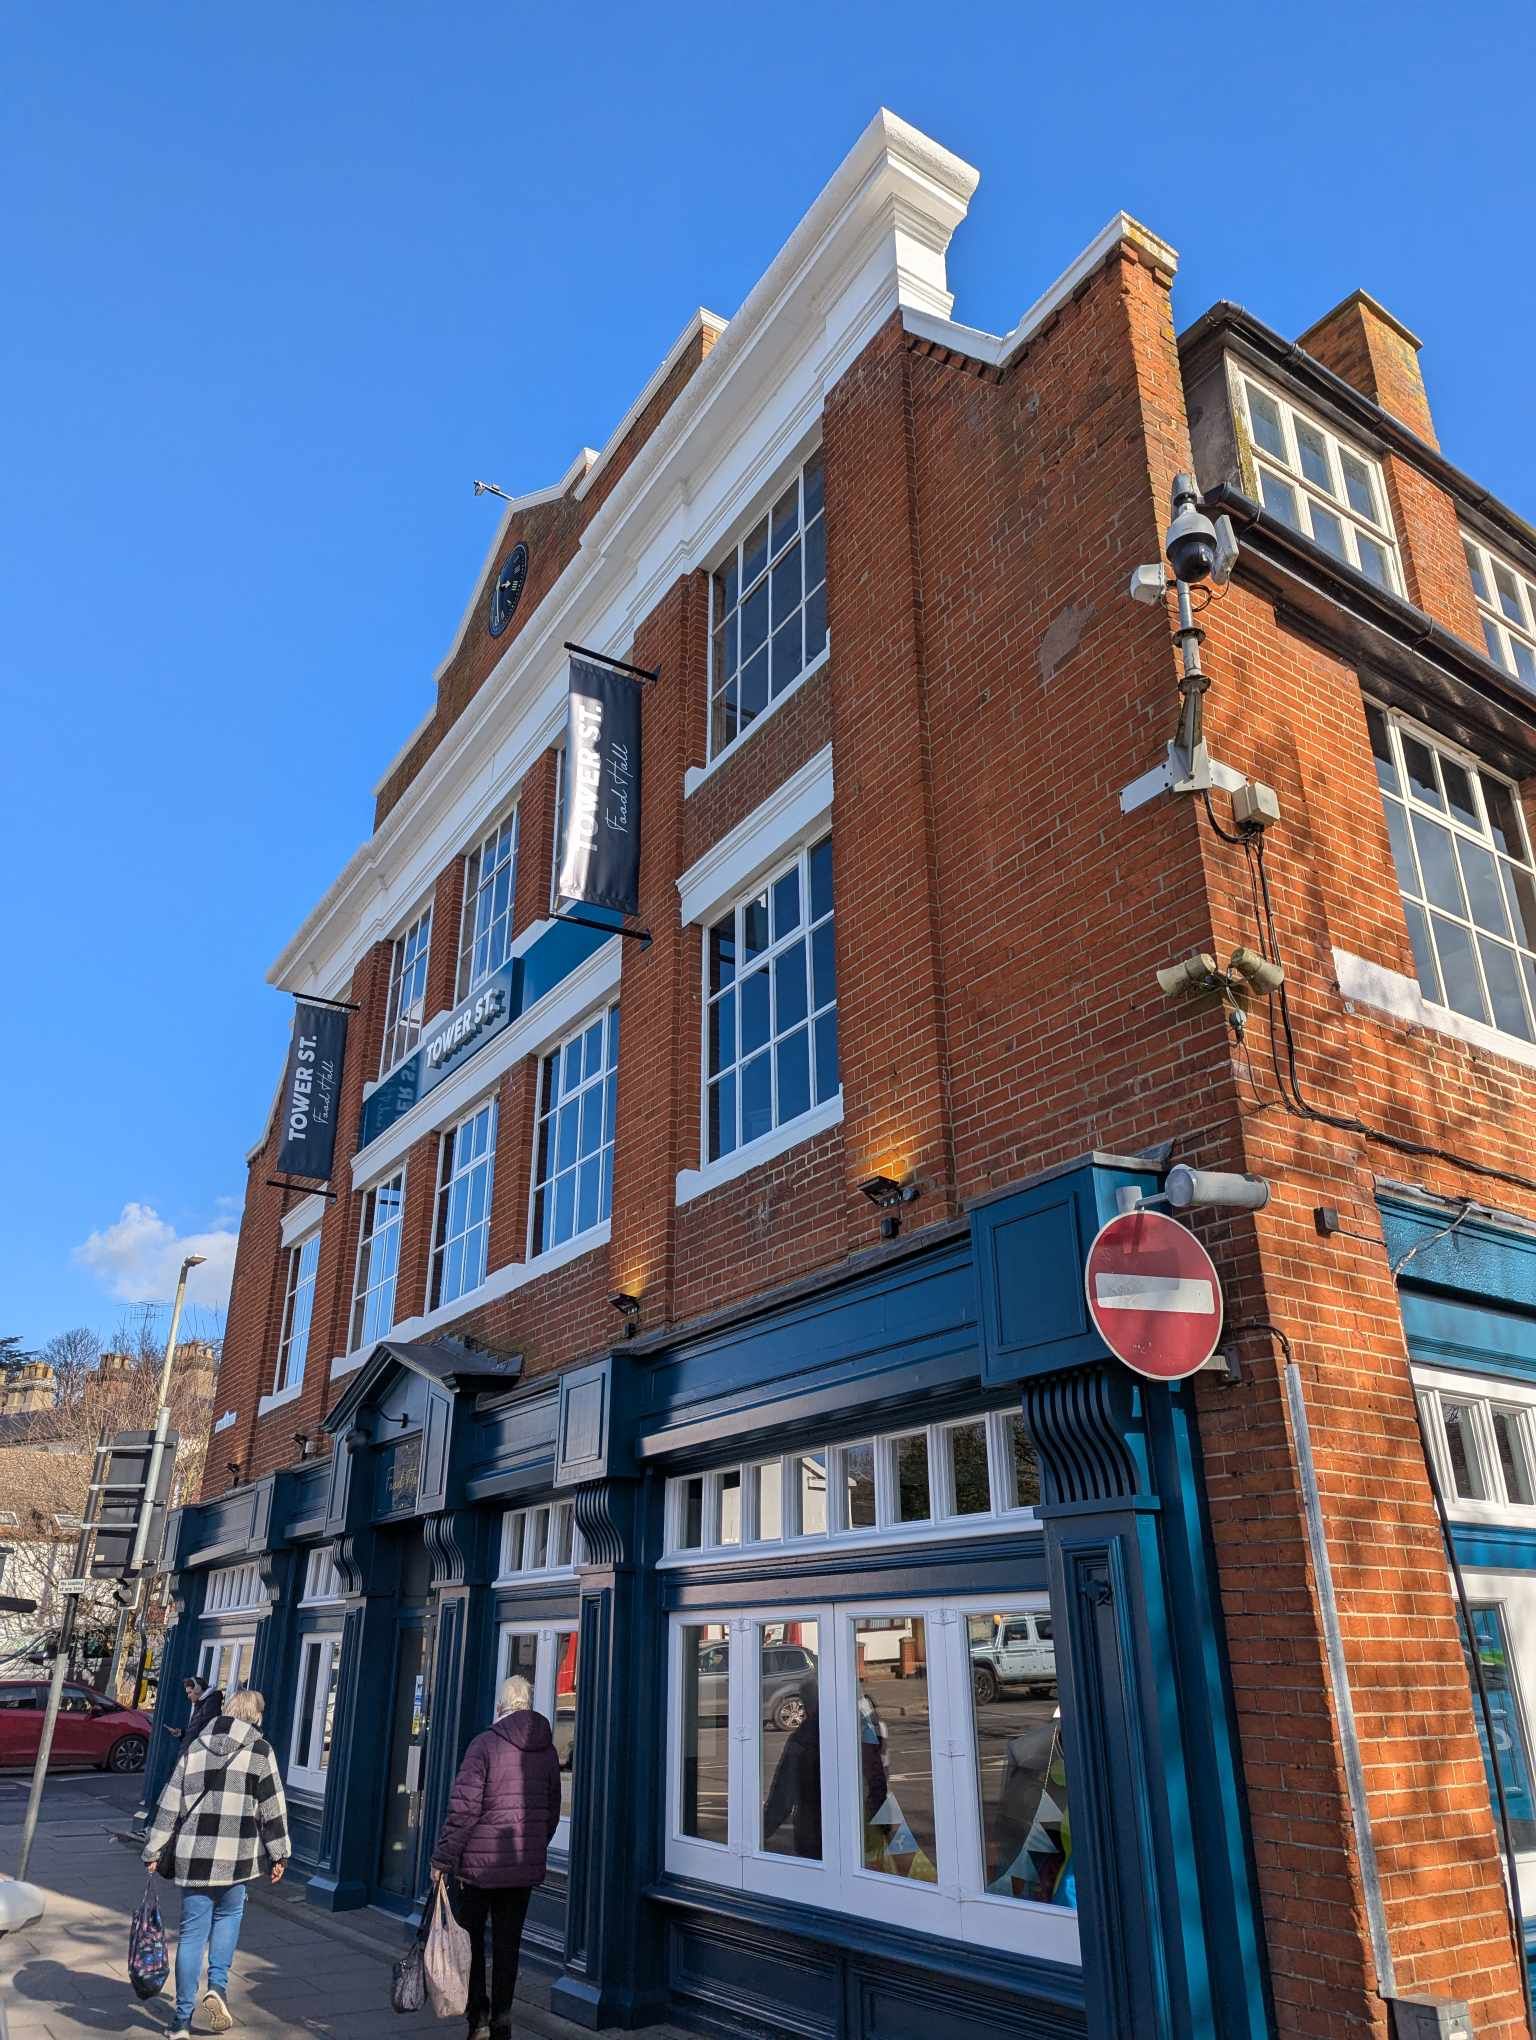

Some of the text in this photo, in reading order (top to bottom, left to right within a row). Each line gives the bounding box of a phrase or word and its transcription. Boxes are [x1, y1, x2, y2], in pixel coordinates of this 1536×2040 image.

[576, 703, 602, 852] TOWER ST.
[605, 742, 634, 833] Food Hall
[426, 1008, 473, 1069] TOWER
[288, 1035, 317, 1141] TOWER ST.
[313, 1060, 336, 1125] Food Hall
